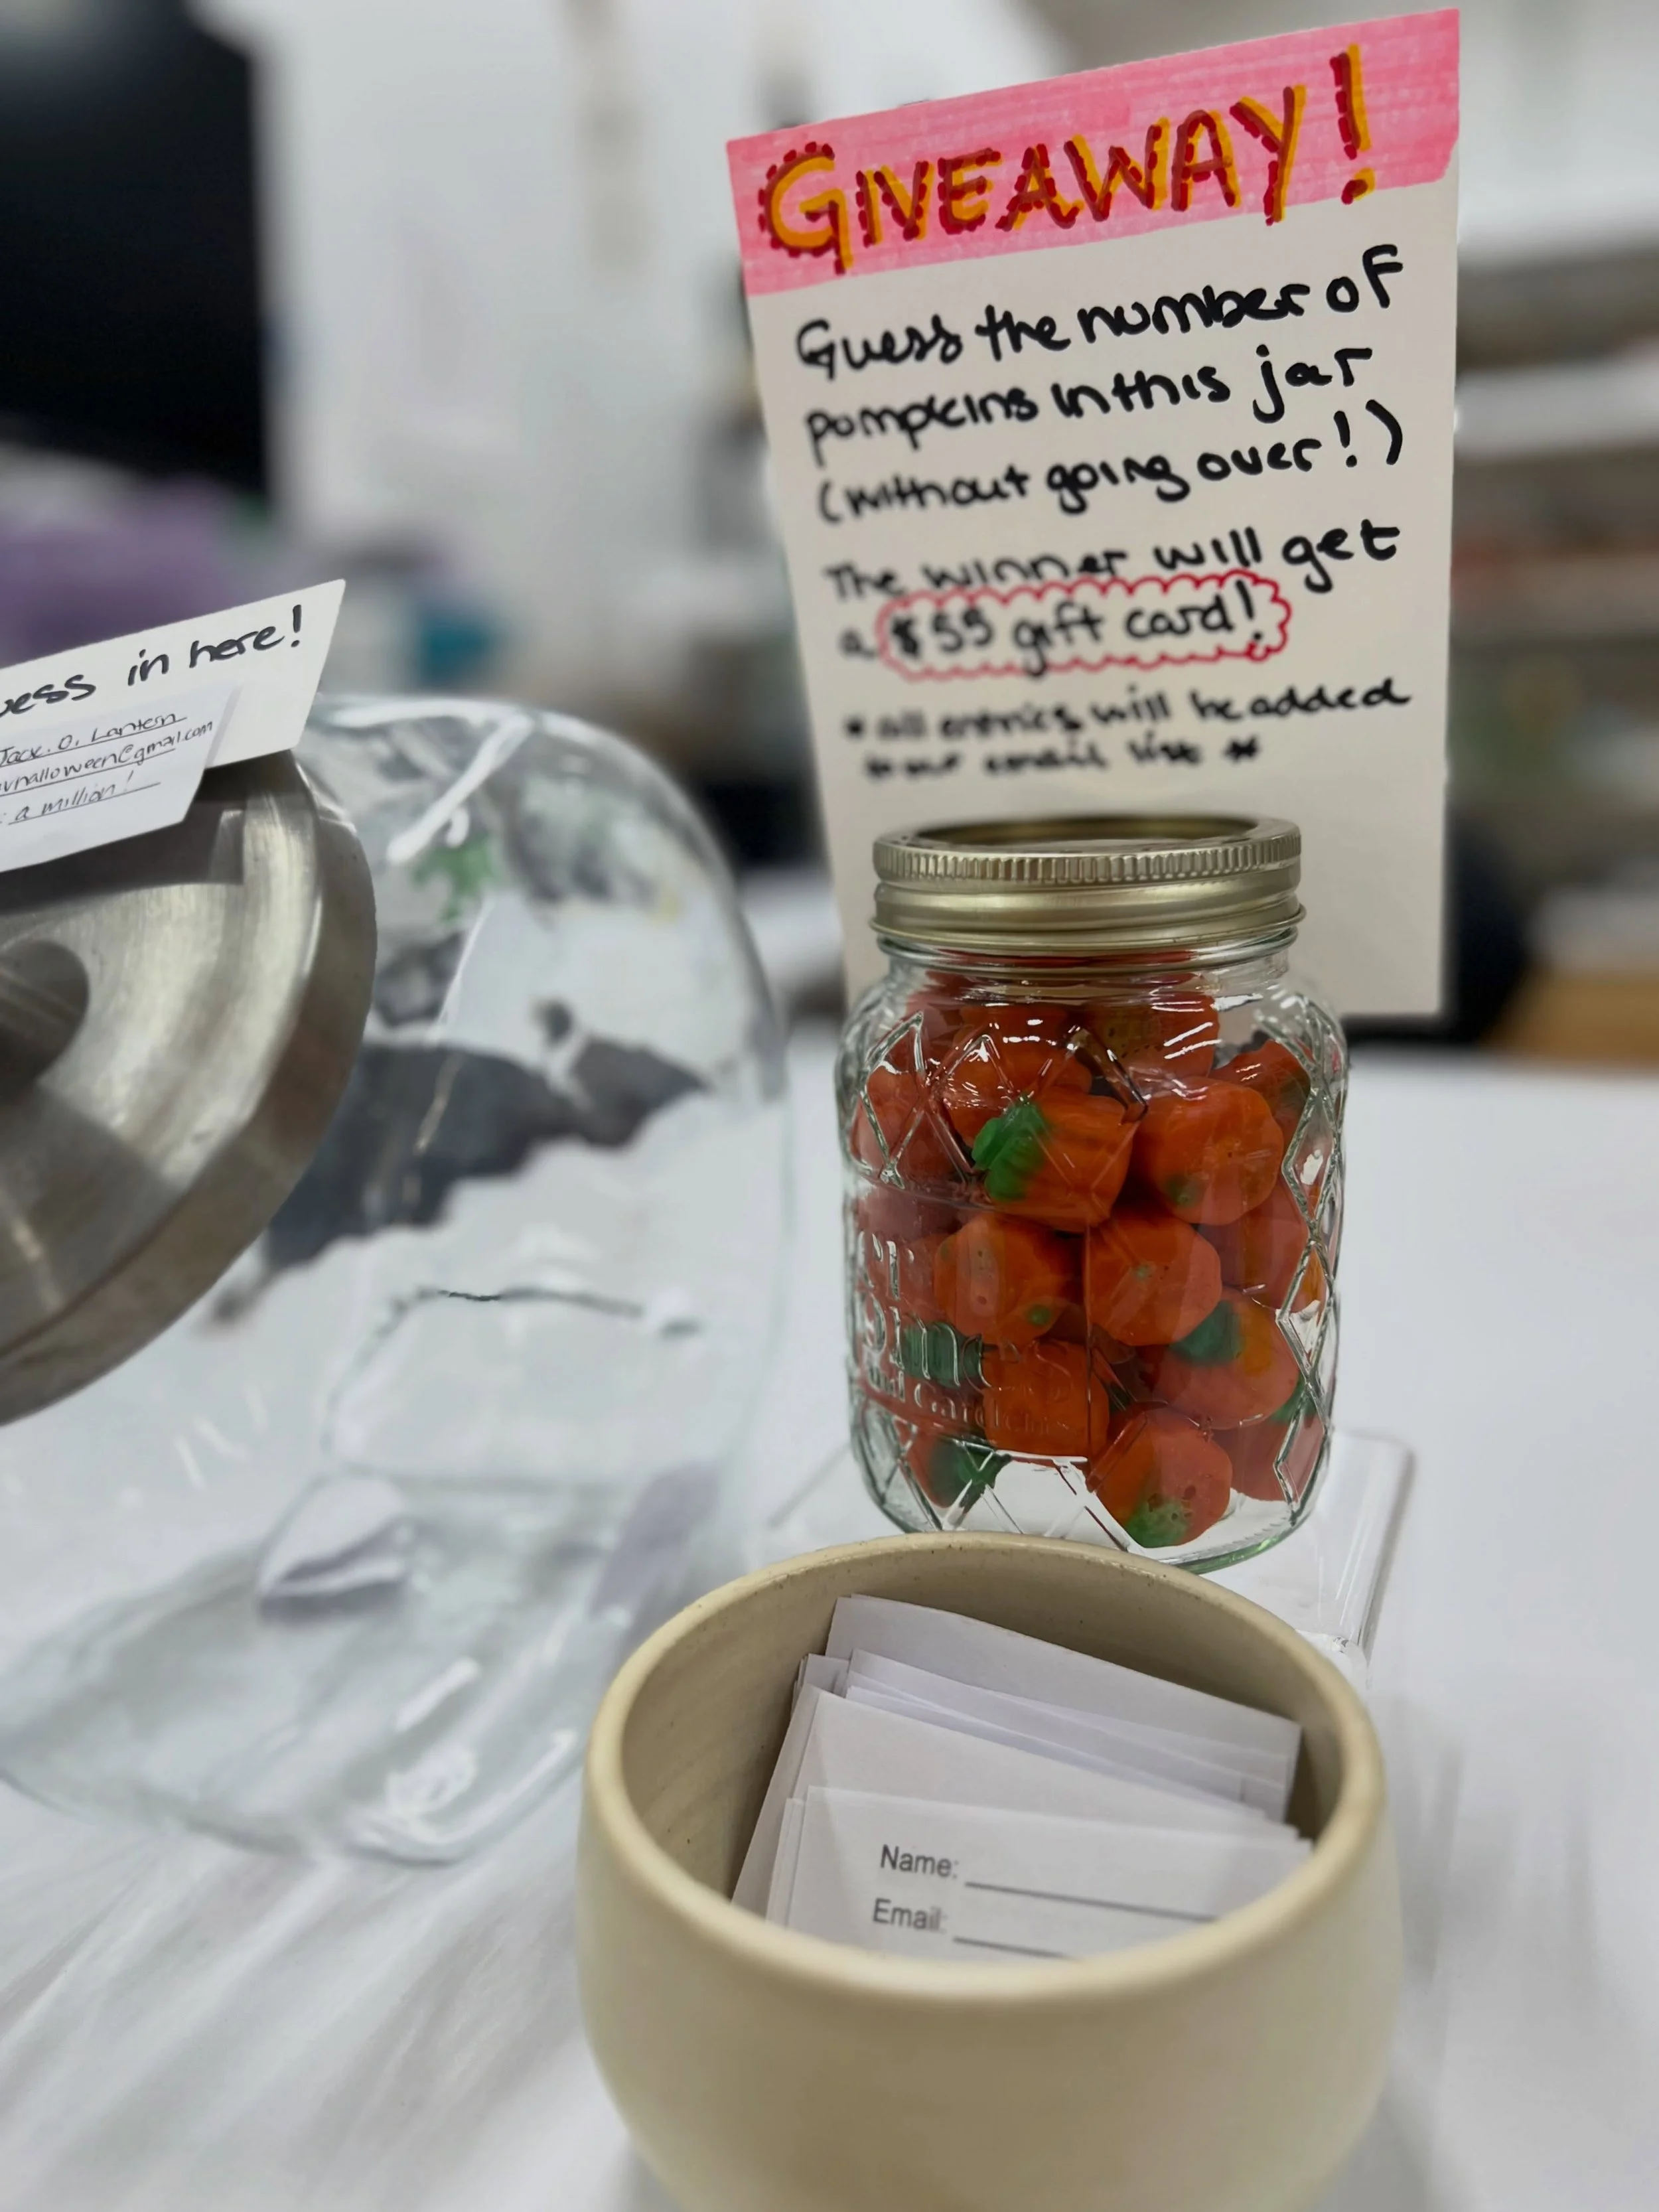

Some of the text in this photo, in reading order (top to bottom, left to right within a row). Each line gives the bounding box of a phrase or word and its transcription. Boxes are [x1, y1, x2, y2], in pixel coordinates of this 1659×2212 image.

[758, 43, 1376, 274] GIVEAWAY!
[795, 244, 1404, 382] Guess the number of
[1252, 343, 1374, 424] jar
[819, 399, 1404, 524] (without going over!)
[824, 518, 1402, 601] The winner will get
[127, 648, 170, 687] in
[188, 603, 303, 669] here!
[837, 627, 877, 662] a
[1011, 599, 1104, 678] gift
[1123, 578, 1265, 644] card!
[1088, 683, 1172, 727] will
[1247, 676, 1413, 718] added
[15, 806, 30, 822] a
[879, 1843, 959, 1879] Name:
[871, 1897, 947, 1934] Email:
